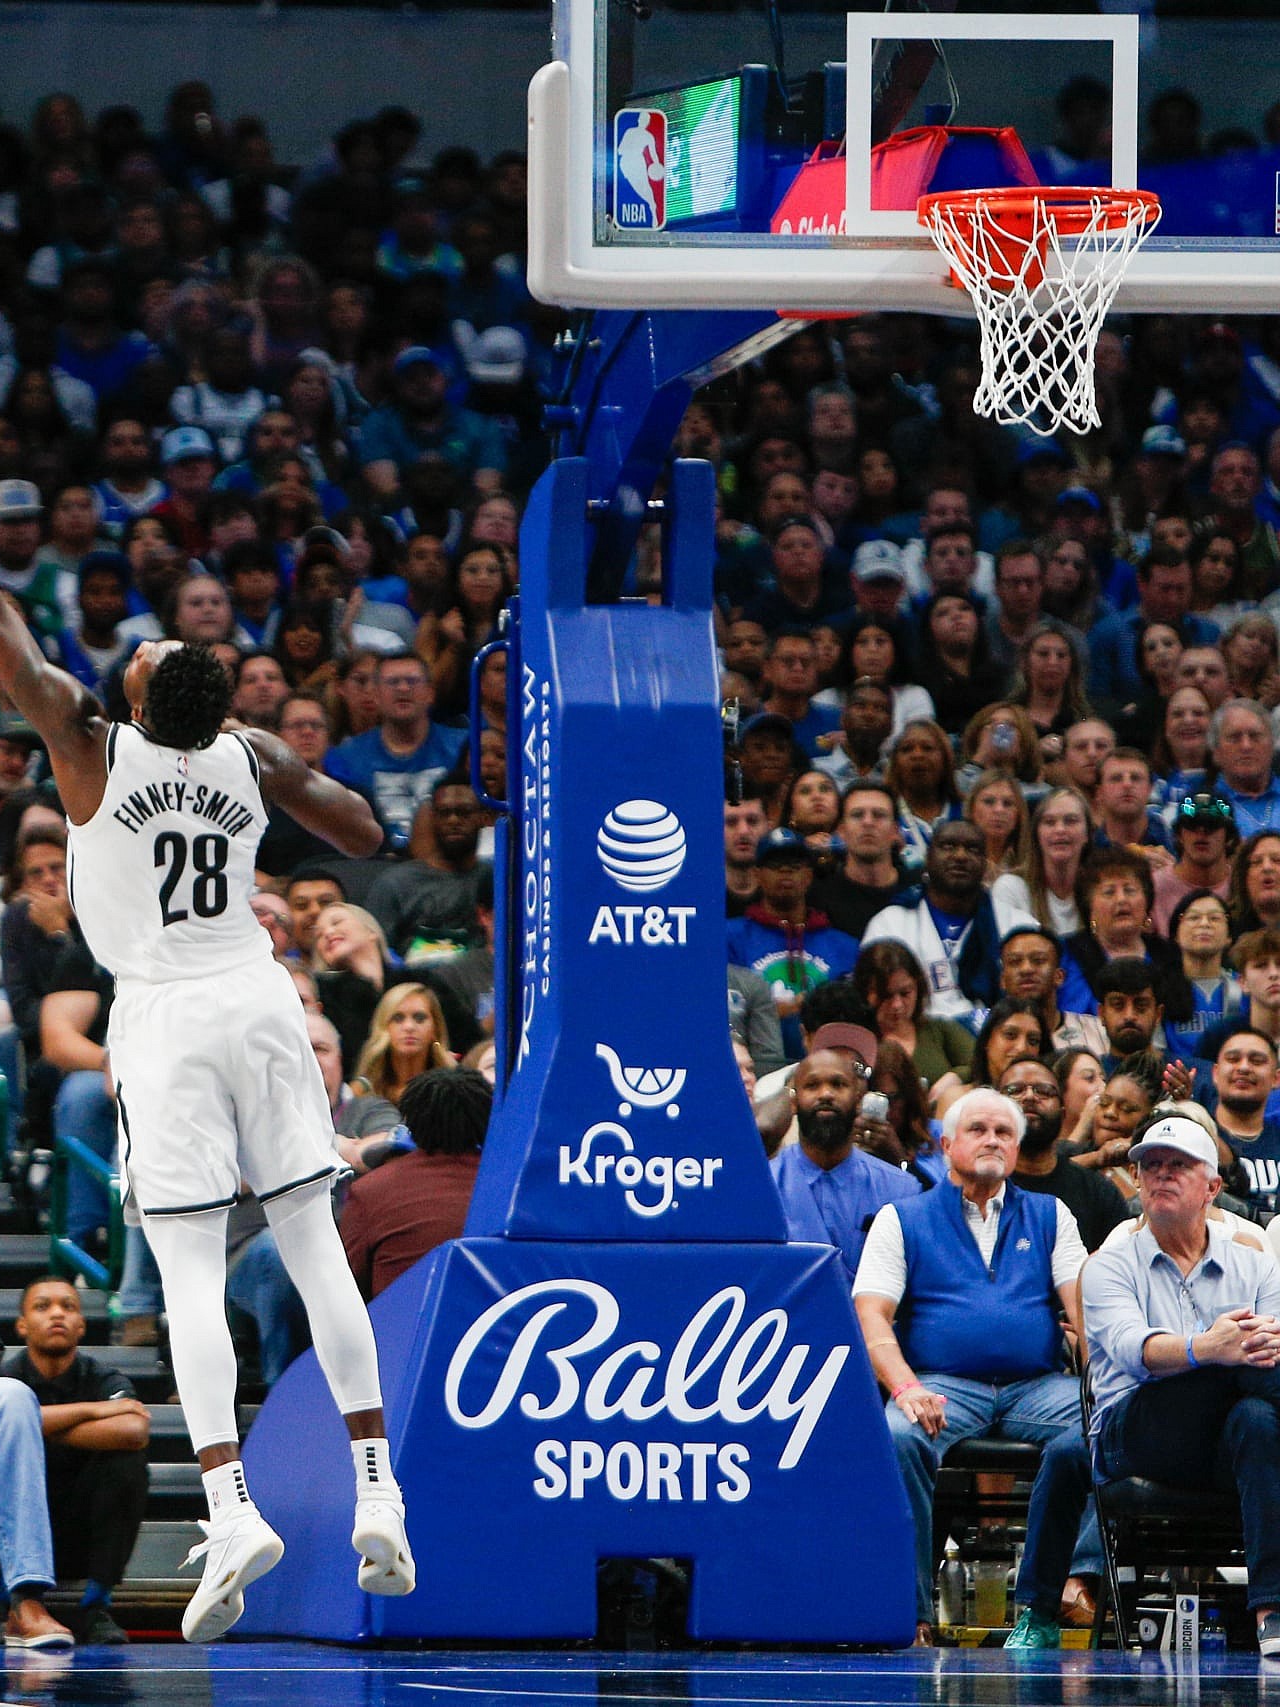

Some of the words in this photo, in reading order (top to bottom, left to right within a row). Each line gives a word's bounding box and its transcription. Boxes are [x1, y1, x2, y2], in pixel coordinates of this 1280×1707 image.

[621, 203, 647, 224] NBA
[113, 781, 254, 838] FINNEY-SMITH
[153, 830, 229, 928] 28
[517, 661, 537, 1073] CHOCTAW
[588, 905, 697, 945] AT&T
[558, 1121, 724, 1217] Kroger
[444, 1277, 852, 1470] Bally
[532, 1438, 752, 1502] SPORTS
